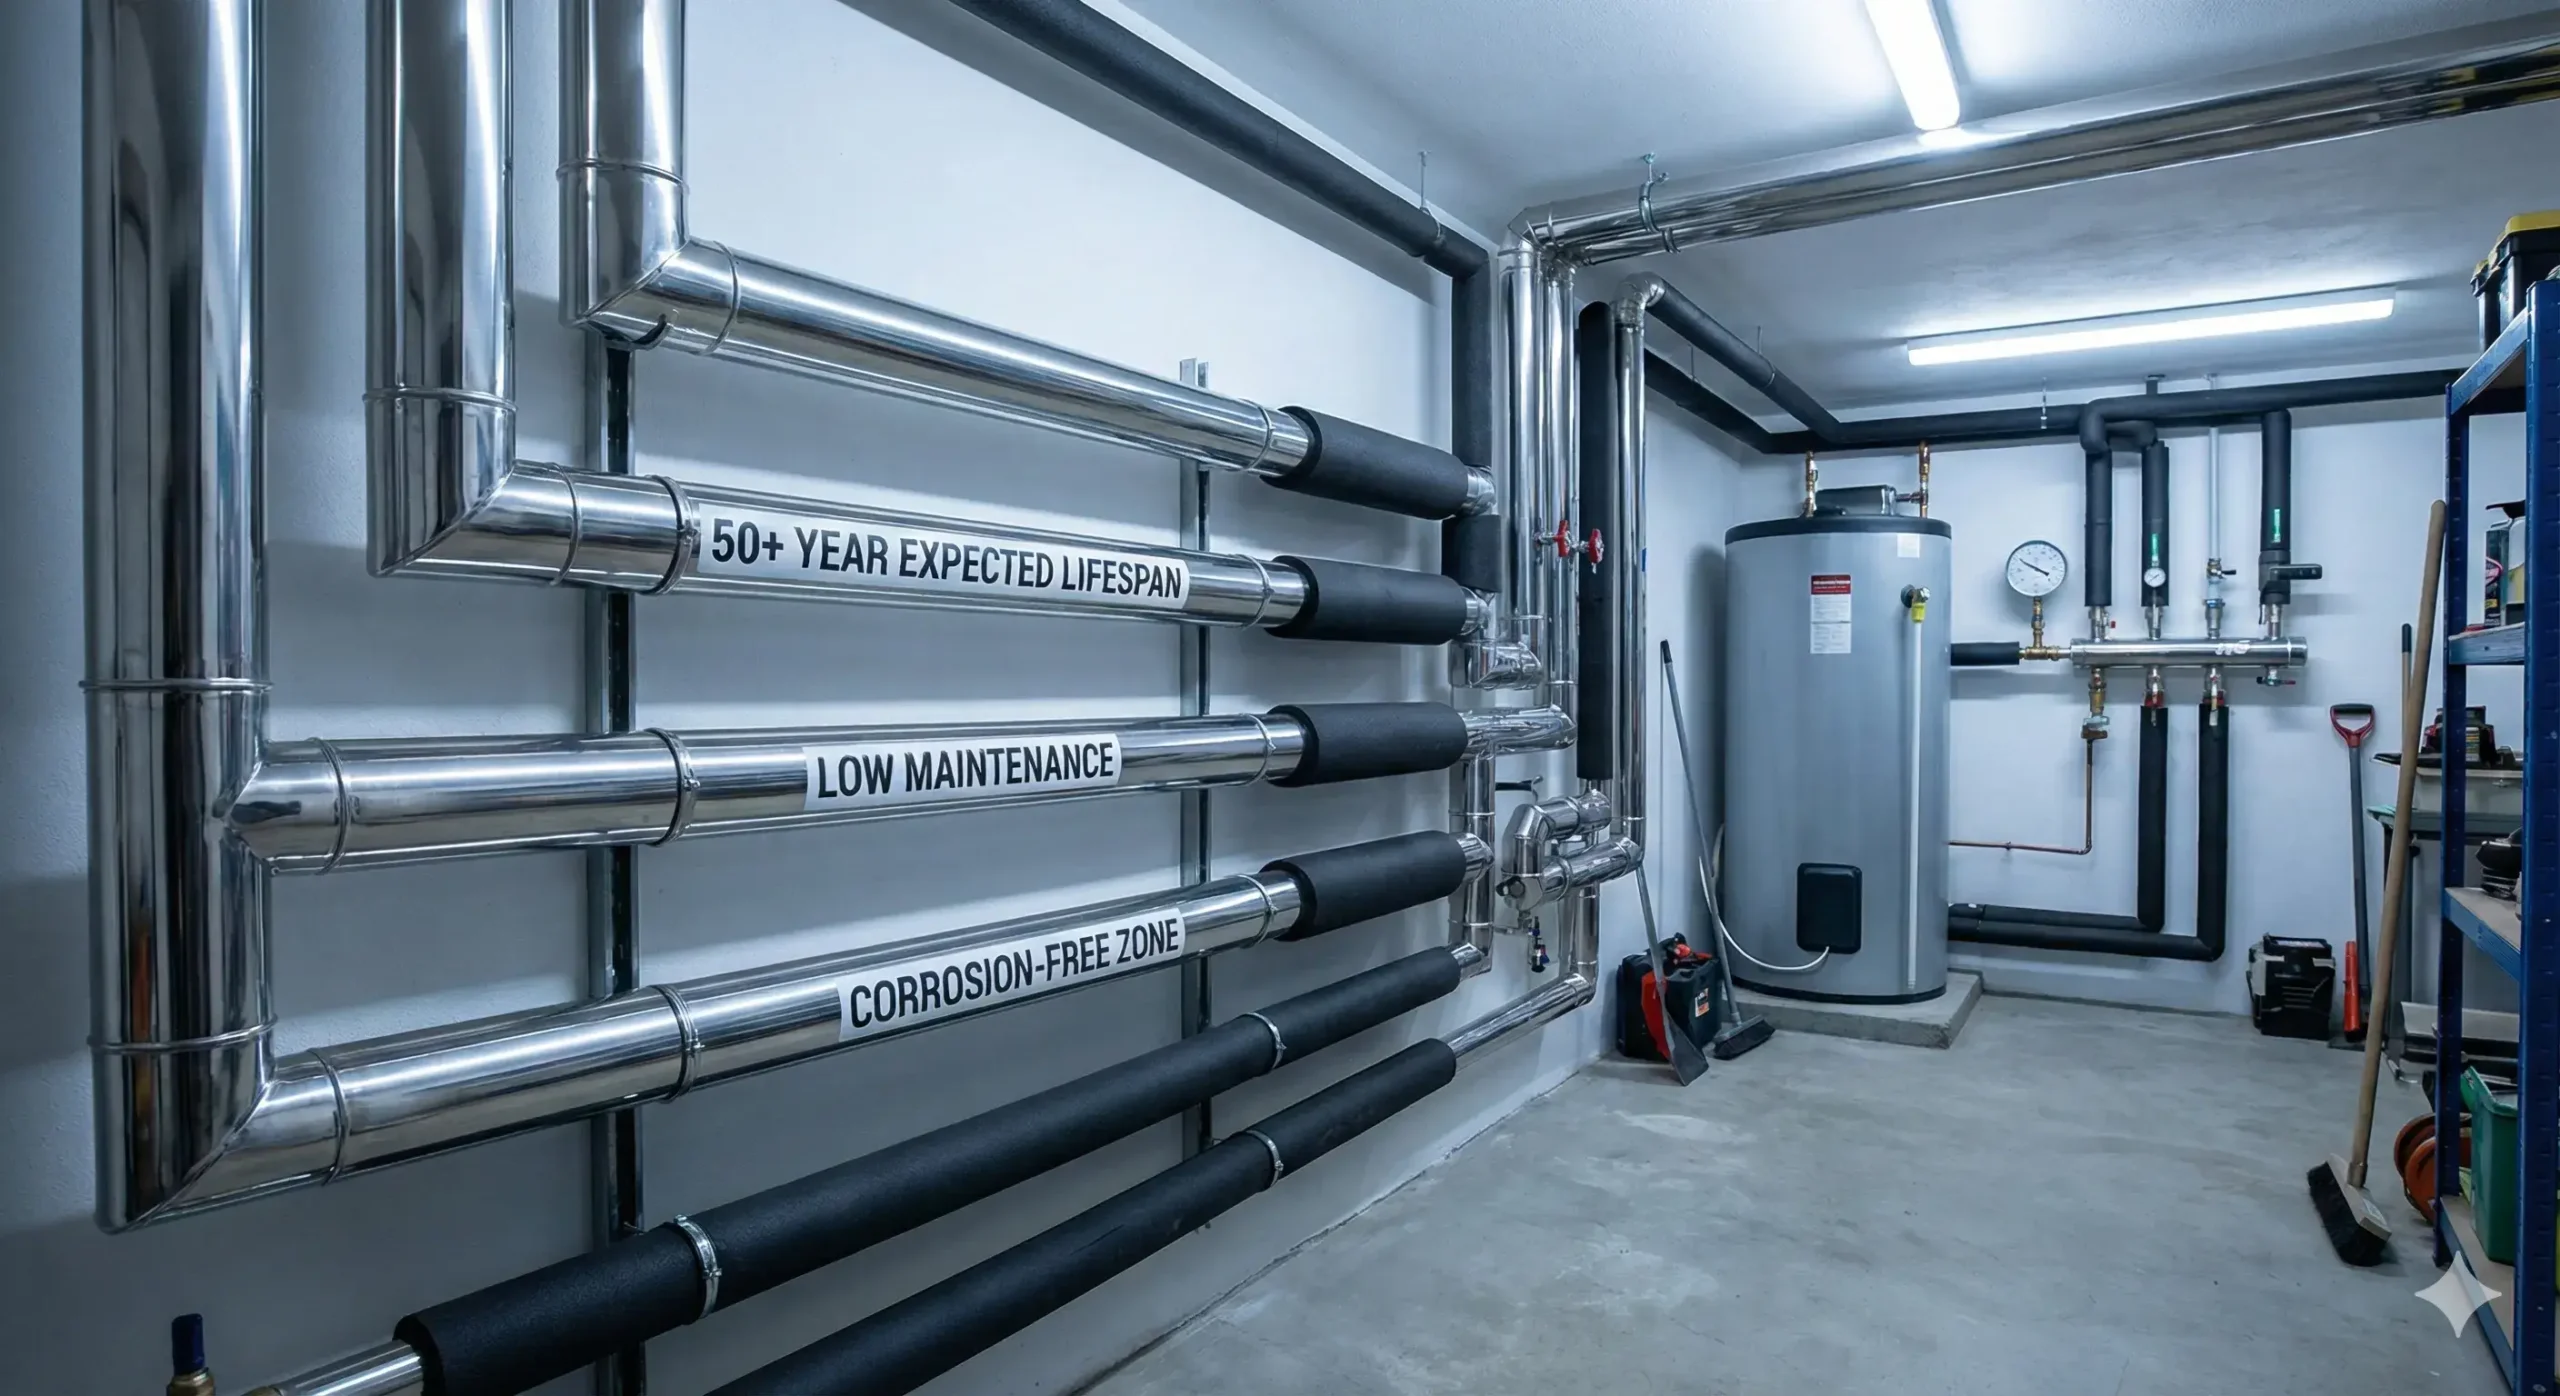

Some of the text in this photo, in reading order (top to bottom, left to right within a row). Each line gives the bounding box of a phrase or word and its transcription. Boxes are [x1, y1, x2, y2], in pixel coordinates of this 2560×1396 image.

[711, 518, 1181, 599] 50+ YEAR EXPECTED LIFESPAN
[817, 742, 1113, 798] LOW MAINTENANCE
[850, 918, 1180, 1029] CORROSION-FREE ZONE
